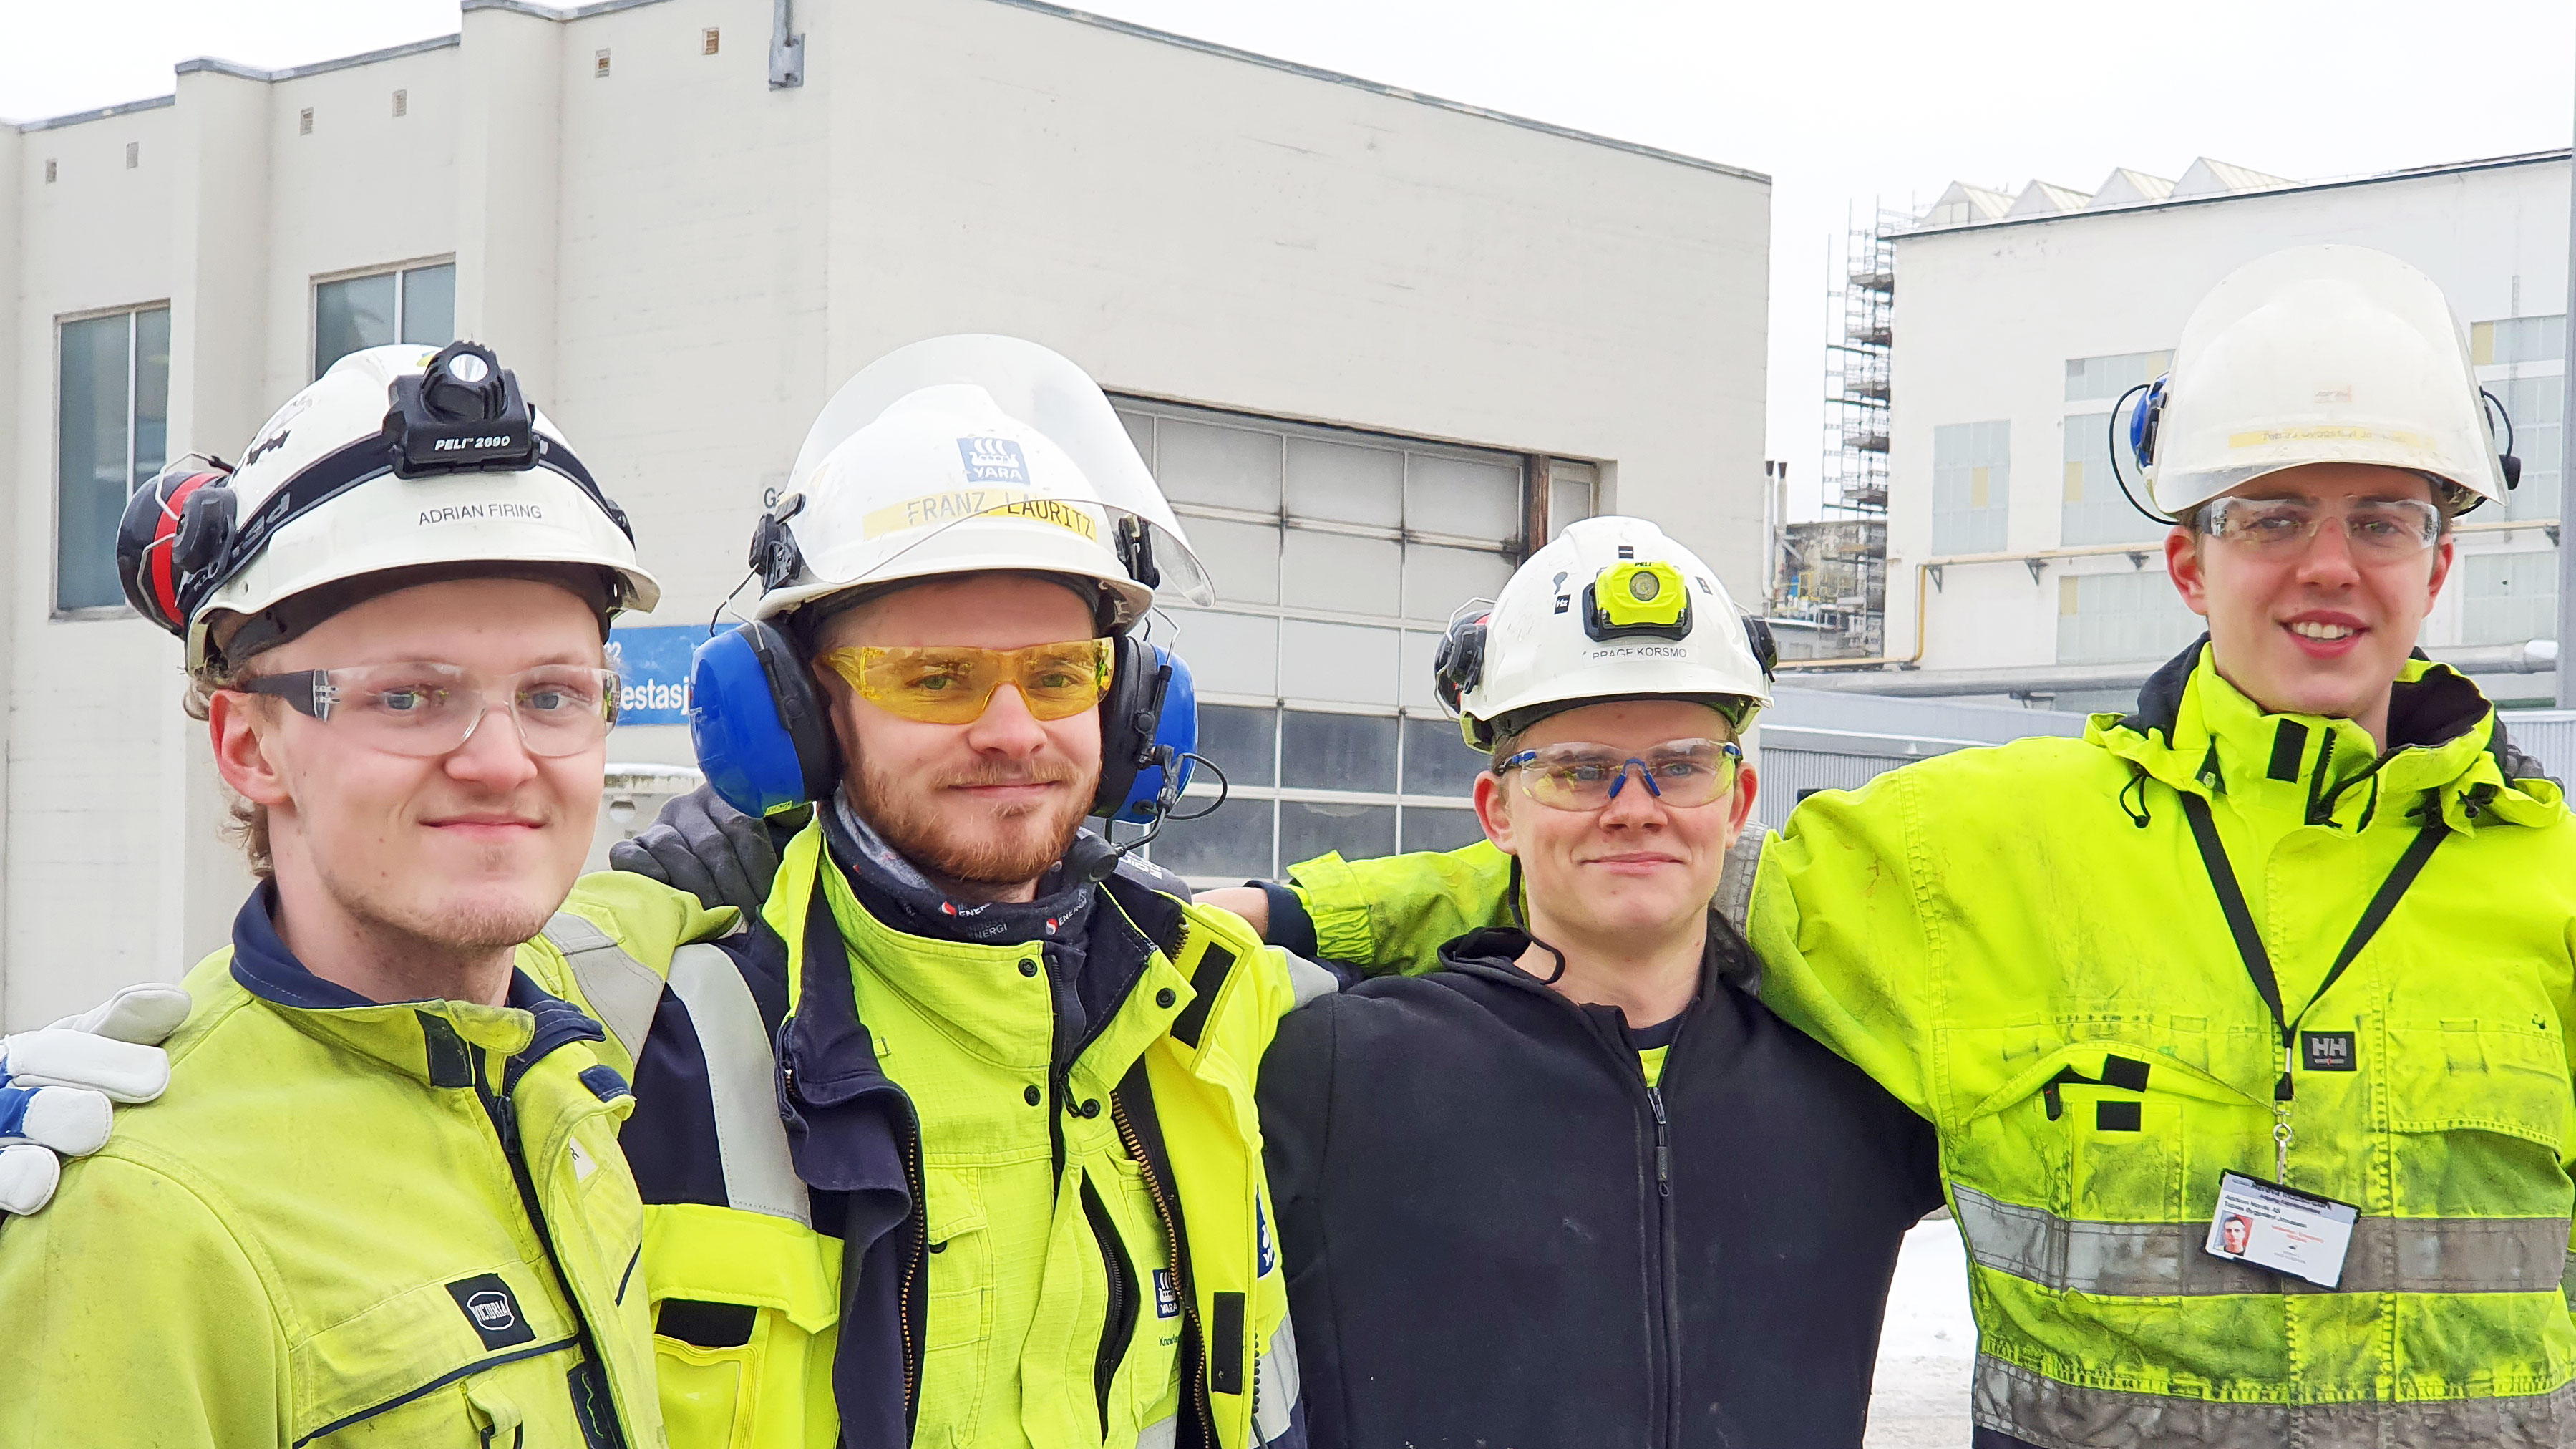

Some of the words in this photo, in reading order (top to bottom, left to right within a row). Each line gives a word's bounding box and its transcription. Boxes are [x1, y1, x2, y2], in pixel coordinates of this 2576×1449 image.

[973, 466, 1023, 480] YARA
[419, 504, 484, 526] ADRIAN
[488, 503, 542, 519] FIRING
[906, 491, 989, 526] FRANZ
[1005, 491, 1094, 541] LAURITZ
[1637, 646, 1687, 658] KORSMO
[2312, 1037, 2347, 1057] HH
[470, 1299, 510, 1322] VICTORIA
[1160, 1303, 1178, 1314] YARA
